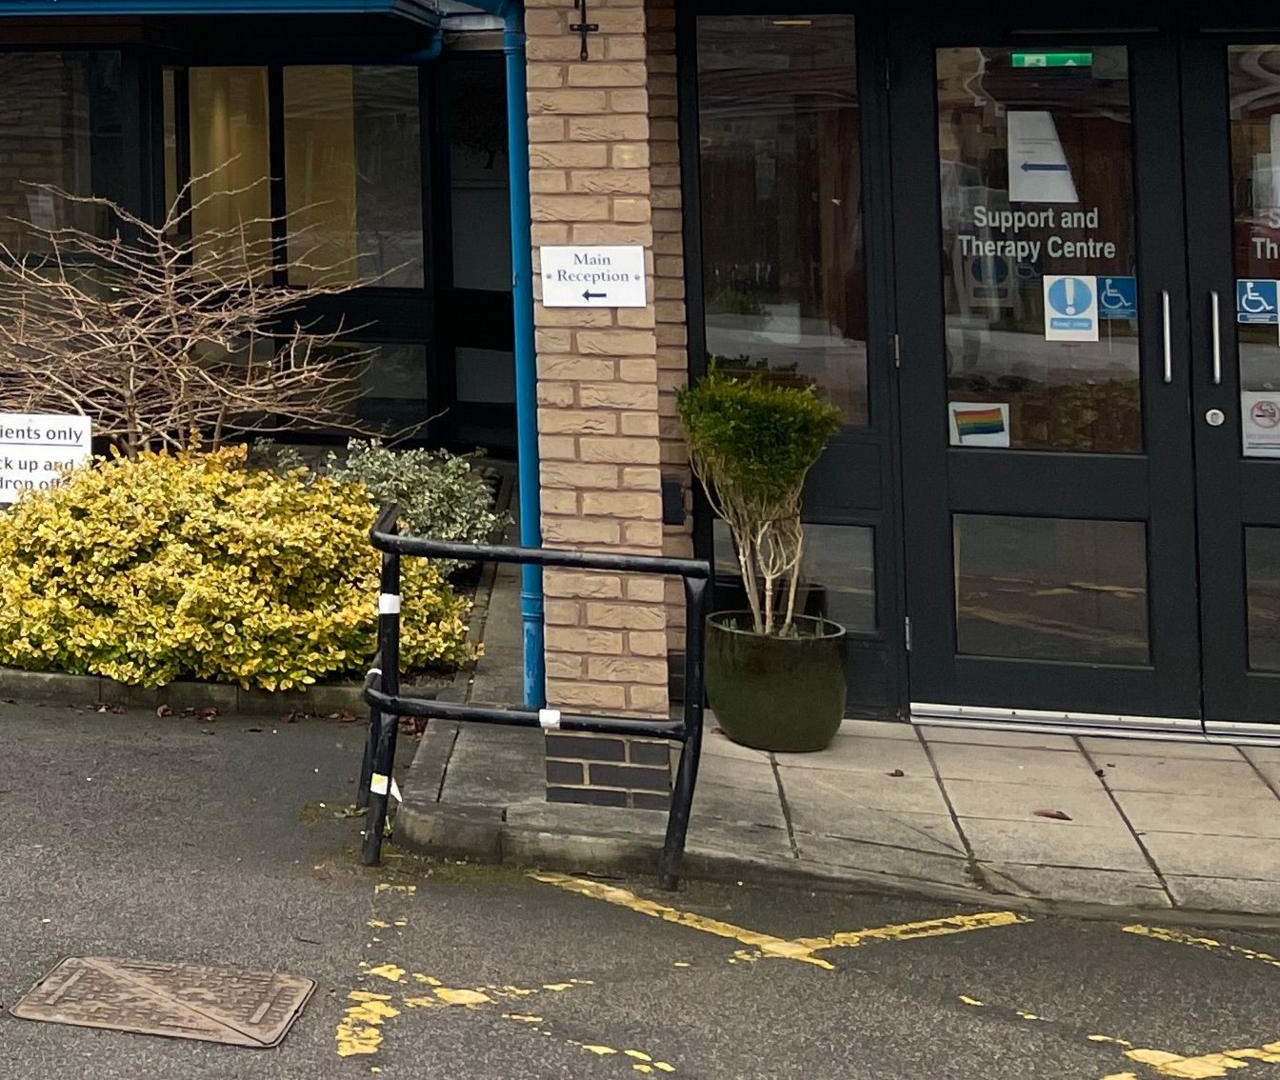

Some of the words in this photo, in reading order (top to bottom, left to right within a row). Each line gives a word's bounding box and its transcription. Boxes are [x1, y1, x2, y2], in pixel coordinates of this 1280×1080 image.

[974, 205, 1055, 233] Support
[1061, 207, 1098, 229] and
[957, 235, 1041, 264] Therapy
[1047, 235, 1116, 259] Centre
[573, 253, 611, 265] Main
[557, 269, 630, 285] Reception
[46, 426, 84, 444] only
[18, 459, 39, 473] up
[43, 458, 74, 471] and
